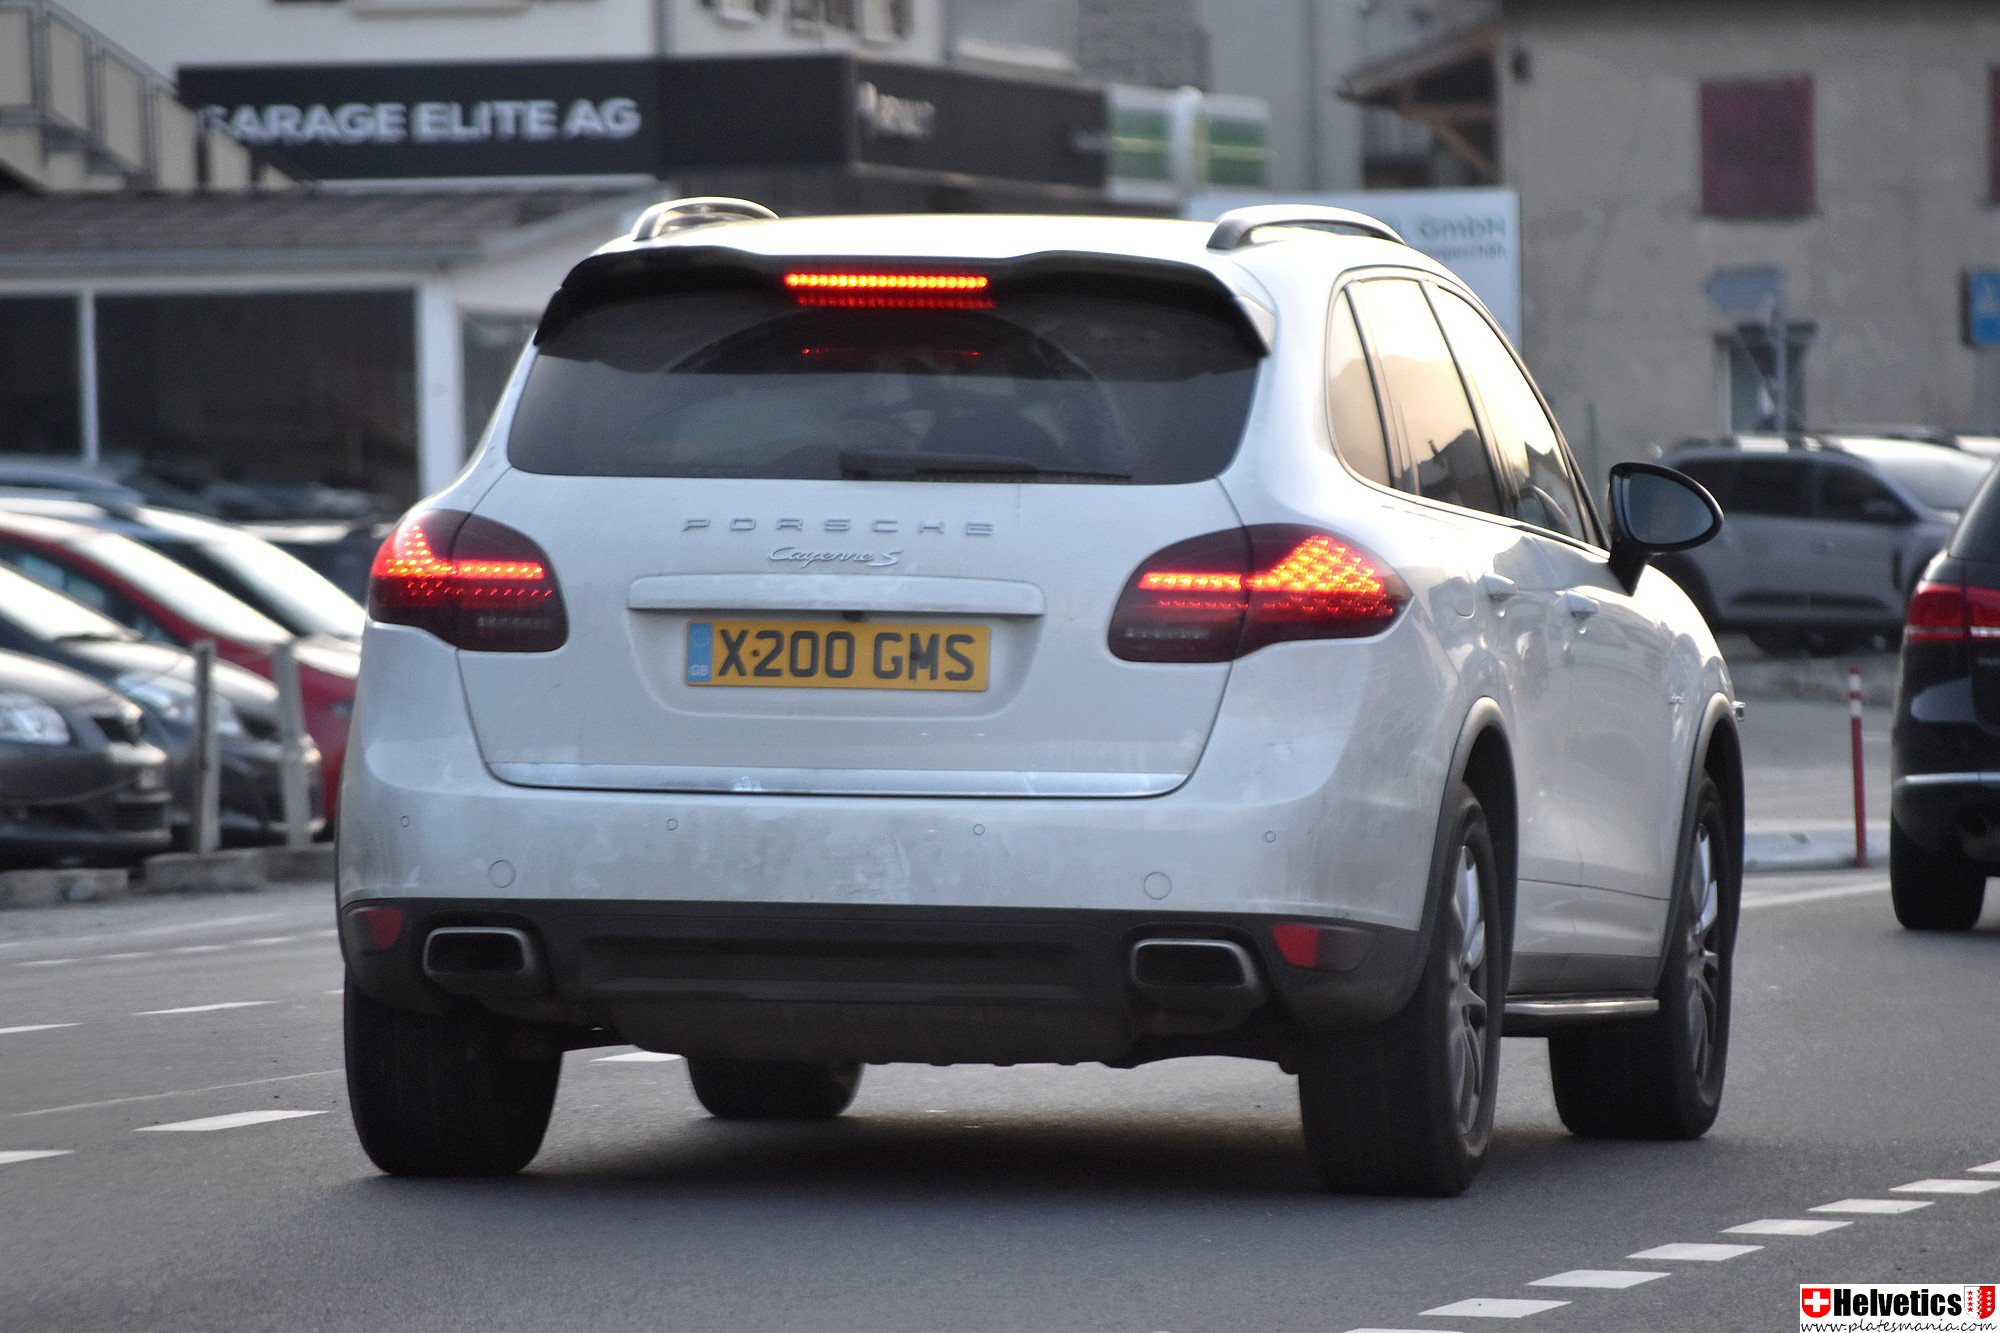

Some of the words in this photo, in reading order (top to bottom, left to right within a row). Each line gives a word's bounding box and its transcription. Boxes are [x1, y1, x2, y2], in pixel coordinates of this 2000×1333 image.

[412, 100, 557, 143] ELITE
[565, 97, 642, 140] AG
[682, 516, 995, 537] PORSCHE
[768, 546, 873, 568] Cayenne
[868, 548, 903, 567] S
[873, 631, 976, 682] GMS
[691, 664, 709, 677] GB
